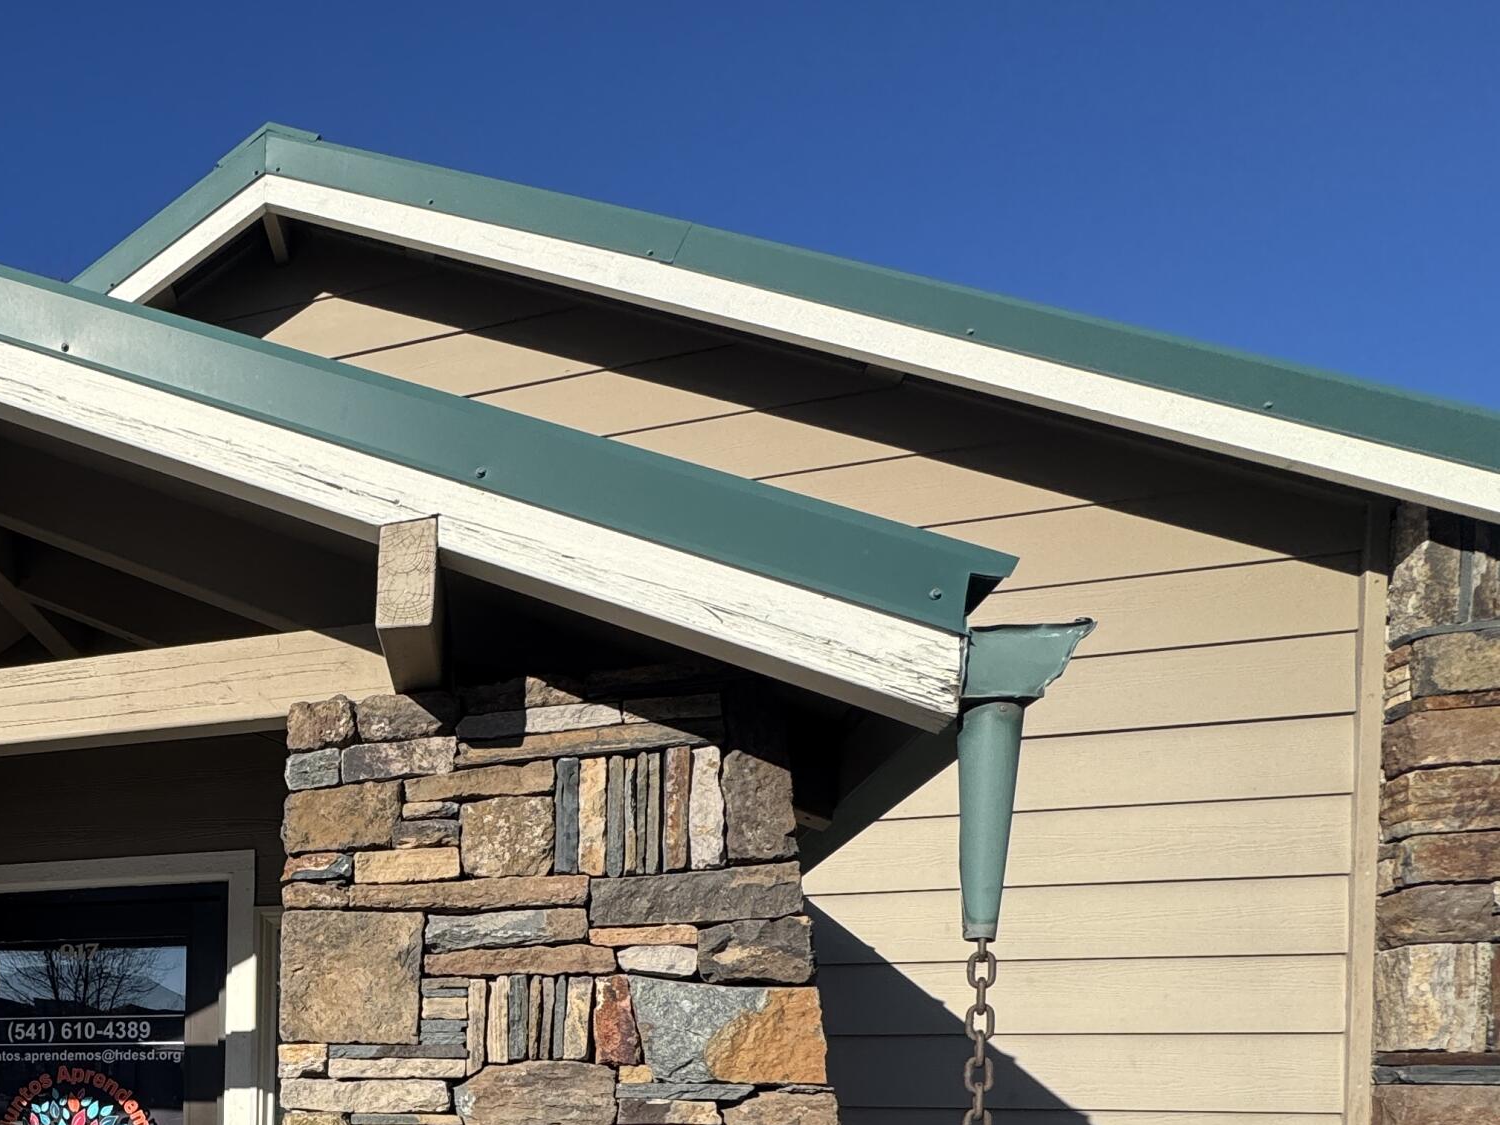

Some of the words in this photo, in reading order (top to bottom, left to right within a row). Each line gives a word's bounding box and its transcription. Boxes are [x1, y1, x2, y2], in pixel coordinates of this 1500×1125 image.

[59, 943, 100, 960] 917
[7, 1021, 55, 1043] (541)
[60, 1021, 151, 1040] 610-4389
